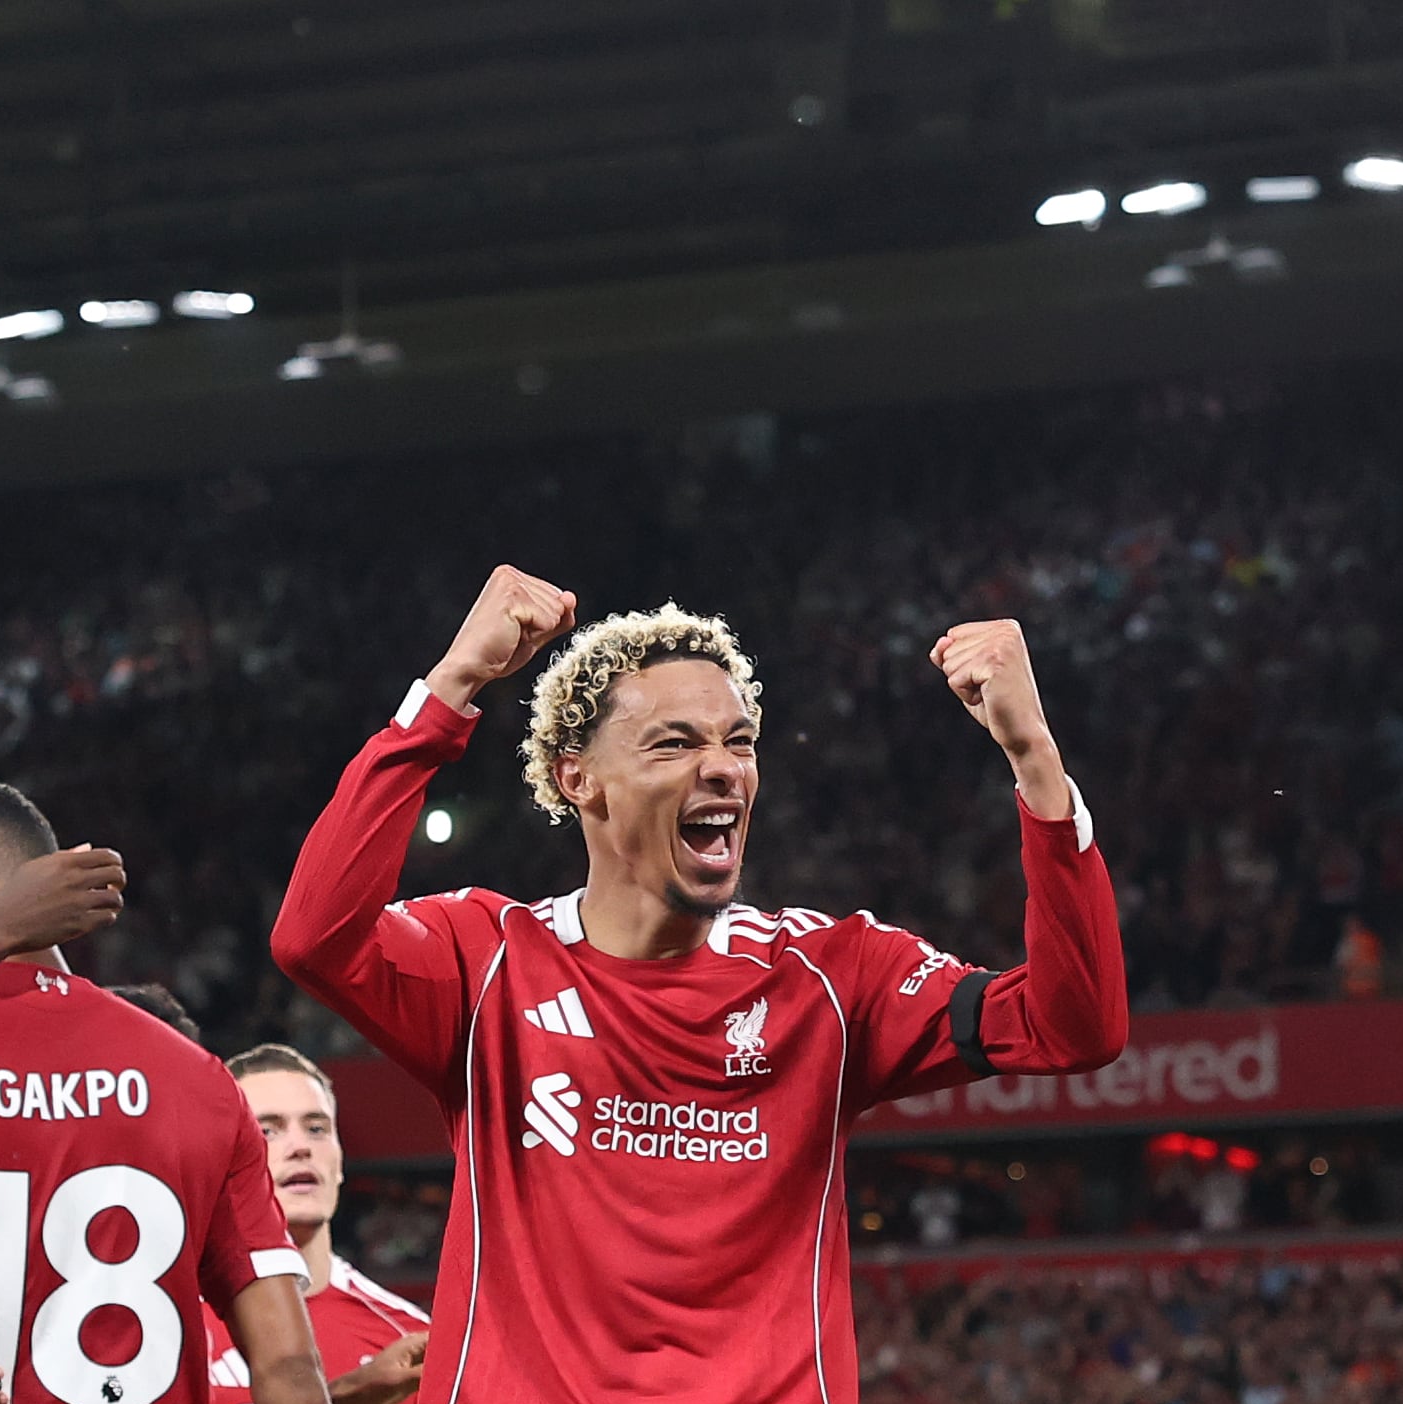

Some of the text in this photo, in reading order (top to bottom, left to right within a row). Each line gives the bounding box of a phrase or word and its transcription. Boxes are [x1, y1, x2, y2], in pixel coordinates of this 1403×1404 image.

[724, 1056, 772, 1077] L.F.C.
[594, 1094, 758, 1134] standard
[591, 1123, 769, 1162] chartered
